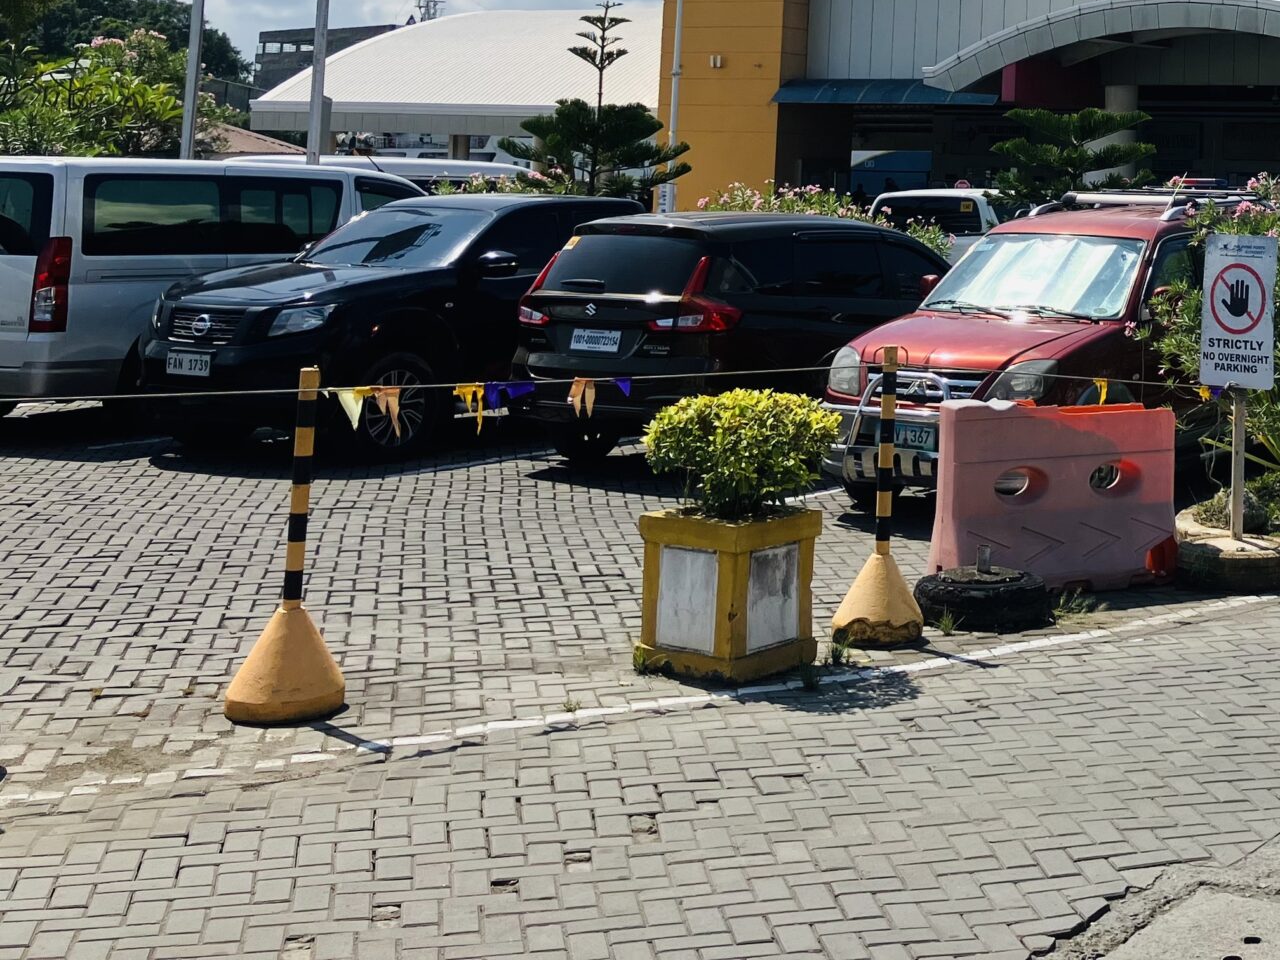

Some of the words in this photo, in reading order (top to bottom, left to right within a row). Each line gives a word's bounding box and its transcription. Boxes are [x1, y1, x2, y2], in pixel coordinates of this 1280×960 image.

[1208, 337, 1264, 351] STRICTLY
[168, 357, 183, 370] FAN
[188, 359, 209, 372] 1739
[1203, 351, 1216, 361] NO
[1218, 352, 1270, 365] OVERNIGHT
[1214, 362, 1258, 374] PARKING
[910, 429, 931, 444] 367
